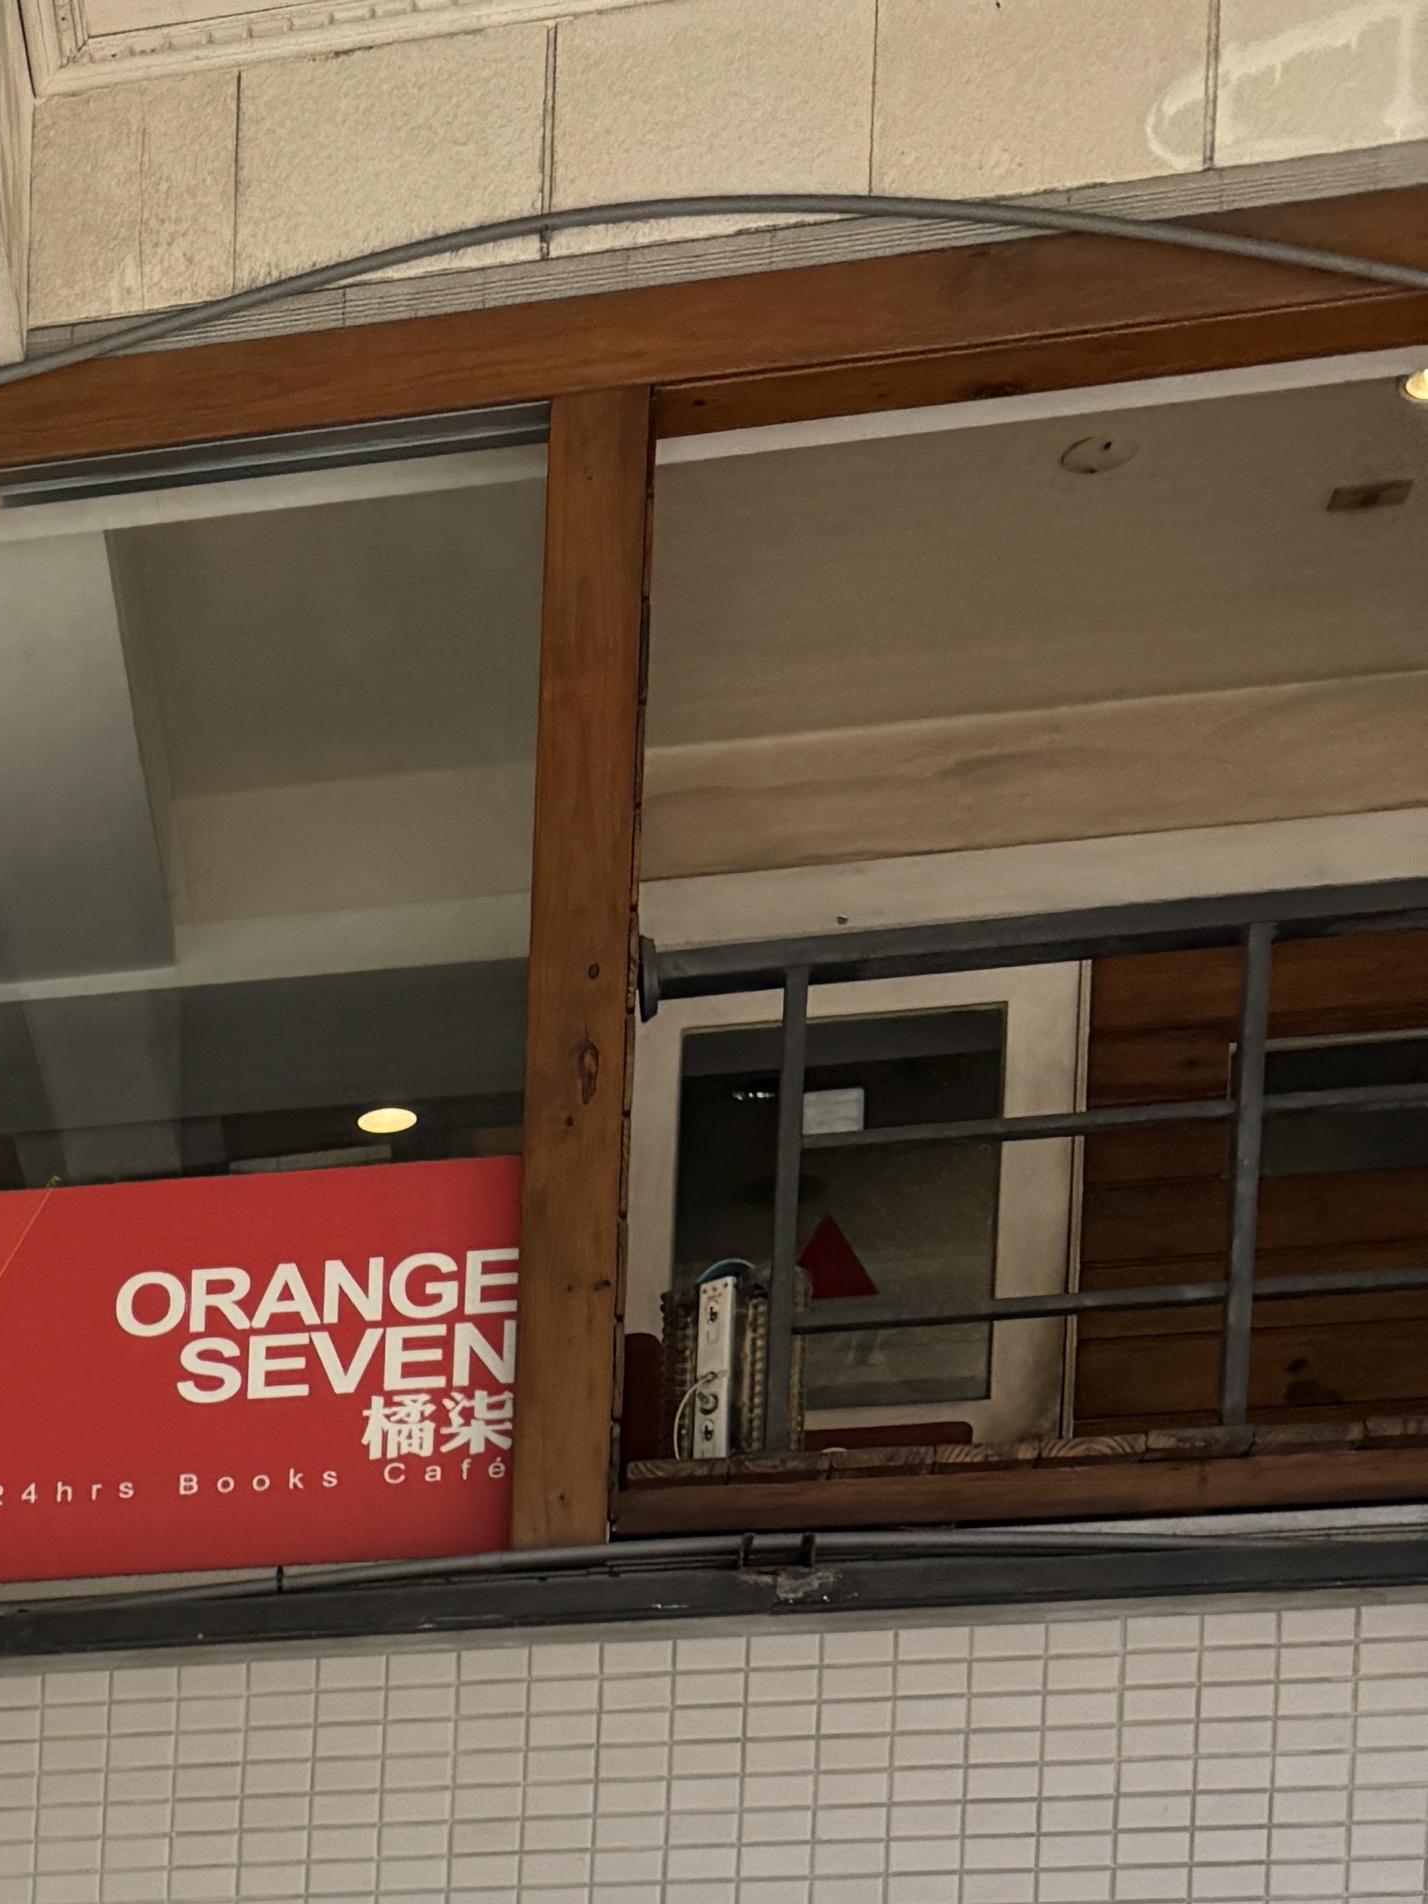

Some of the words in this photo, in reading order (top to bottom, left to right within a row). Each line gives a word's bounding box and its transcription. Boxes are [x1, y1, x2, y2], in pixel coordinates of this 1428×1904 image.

[115, 1247, 520, 1338] ORANGE
[175, 1319, 517, 1405] SEVEN
[361, 1389, 514, 1461] 橘柒
[178, 1467, 338, 1496] Books
[383, 1455, 507, 1485] Café
